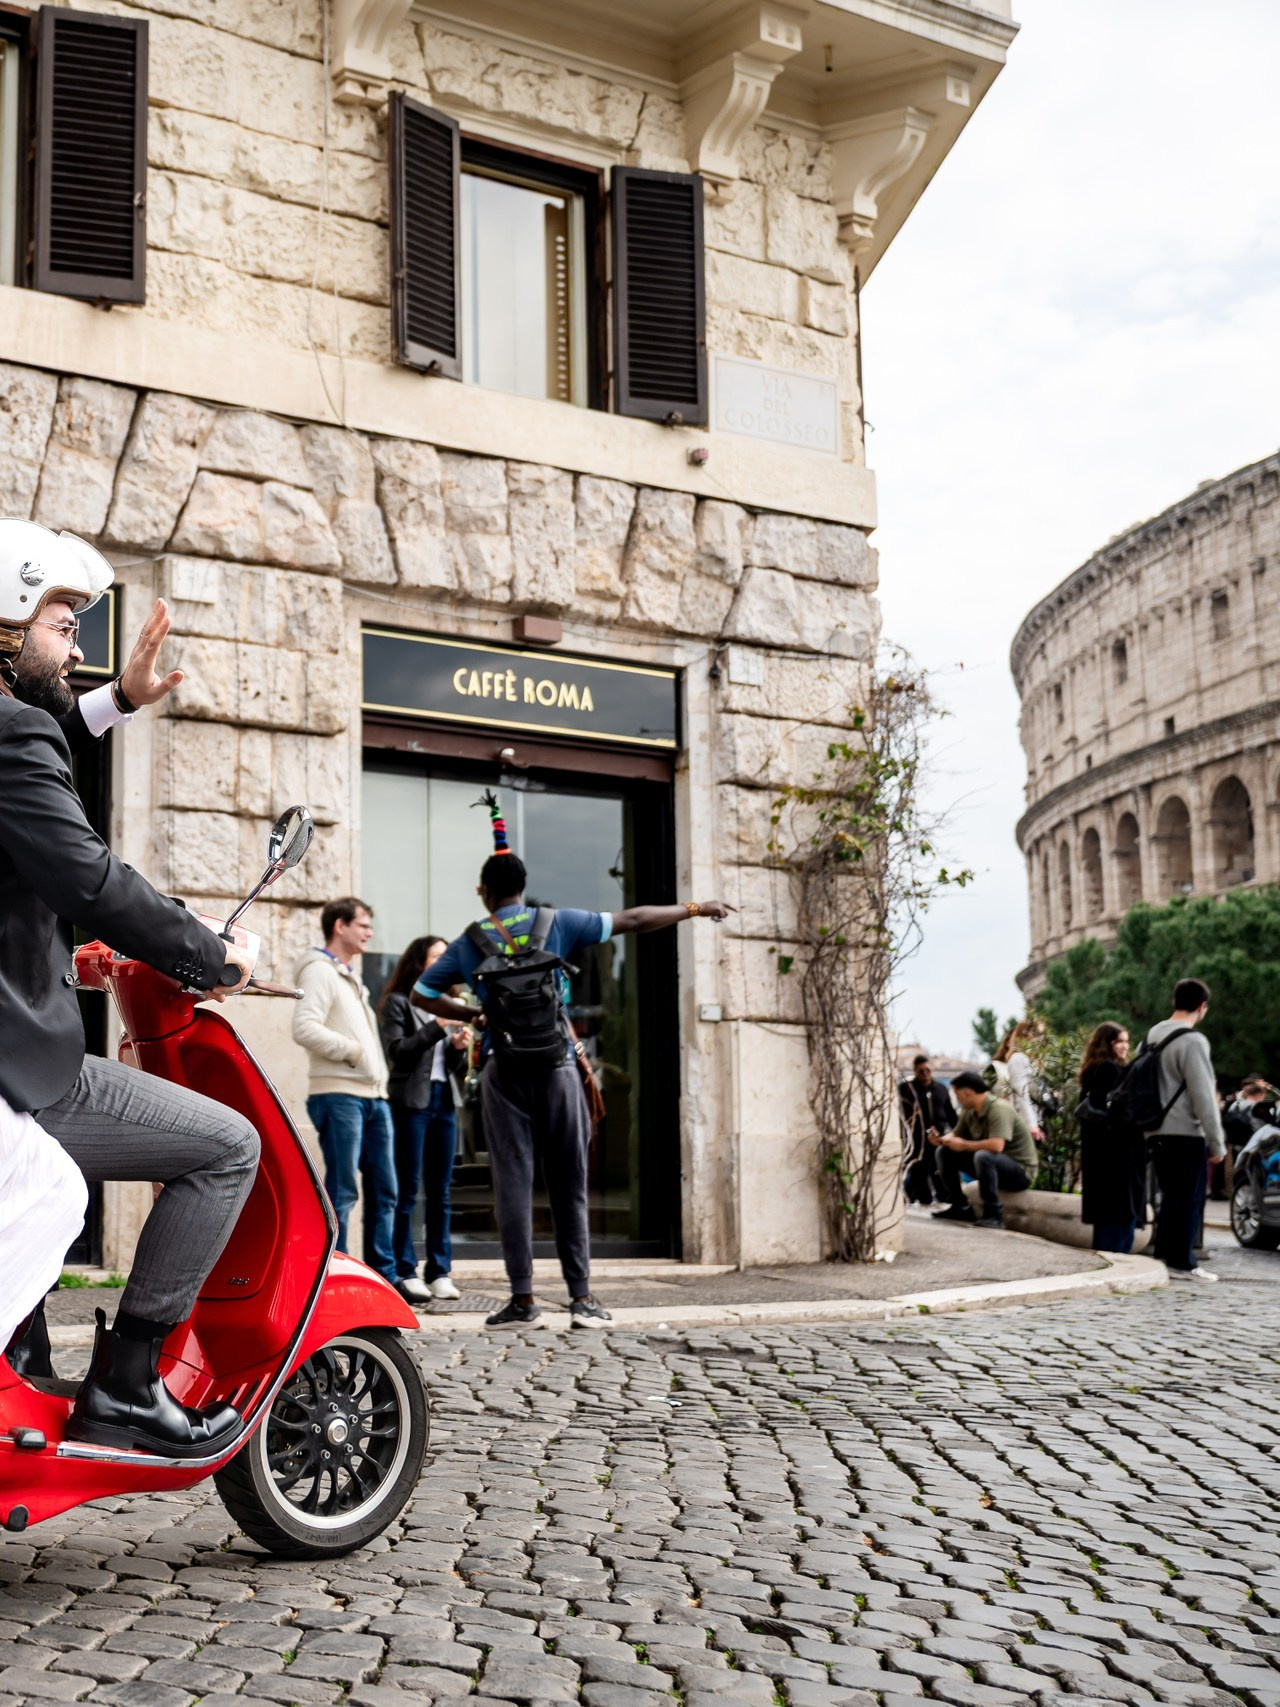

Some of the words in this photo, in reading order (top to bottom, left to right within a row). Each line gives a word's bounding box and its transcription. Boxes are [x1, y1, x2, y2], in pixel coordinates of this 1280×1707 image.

[761, 374, 792, 399] VIA
[763, 397, 791, 416] DEL
[724, 407, 829, 445] COLOSSEO
[453, 667, 518, 702] CAFFÈ
[523, 677, 594, 712] ROMA
